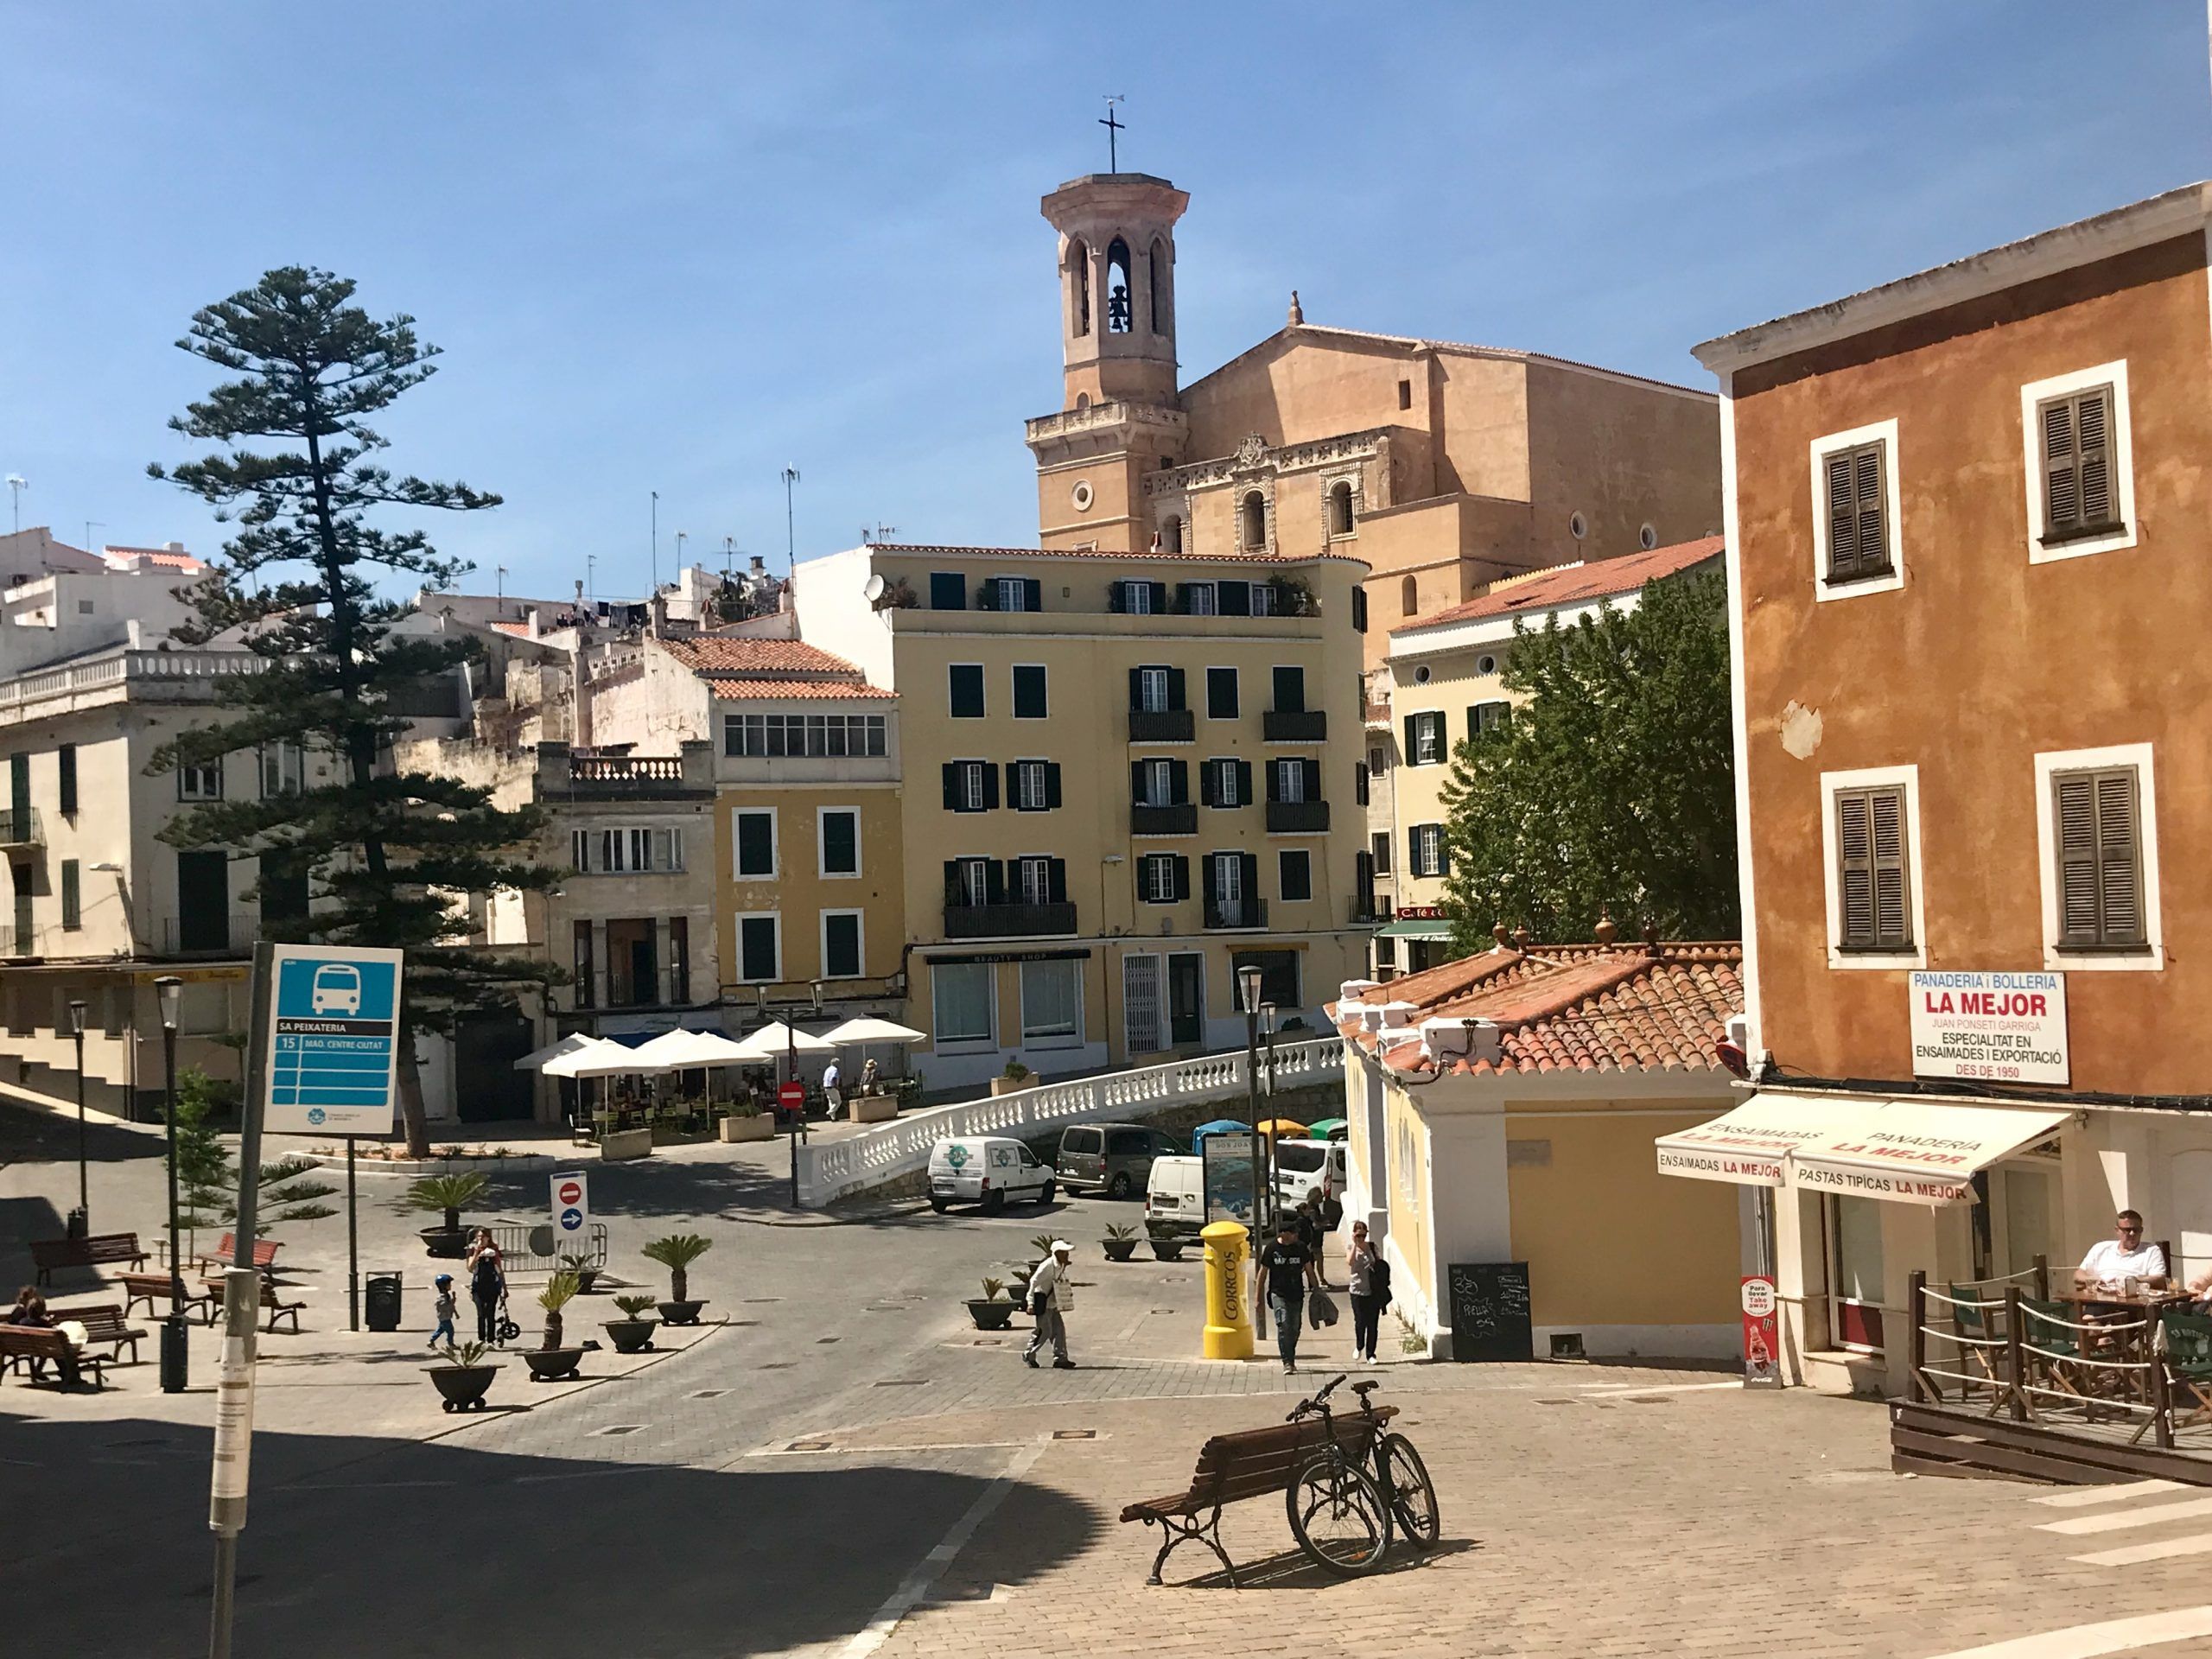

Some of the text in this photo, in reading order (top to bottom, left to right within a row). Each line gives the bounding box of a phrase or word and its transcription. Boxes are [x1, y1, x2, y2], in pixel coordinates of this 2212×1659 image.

[974, 954, 1011, 963] BEAUTY
[1914, 973, 1983, 988] PANADERIA
[1993, 975, 2057, 990] BOLLERIA
[1925, 992, 2047, 1017] LA MEJOR
[279, 1022, 346, 1033] SA PEIXATERIA
[1932, 1019, 2041, 1032] JUAN PONSETI GARRIGA
[282, 1038, 296, 1049] 15
[1942, 1033, 2031, 1048] ESPECIALITAT EN
[1916, 1045, 1984, 1060] ENSAIMADES
[1992, 1049, 2063, 1065] EXPORTACIÓ
[1955, 1064, 2019, 1078] DES DE 1950
[1707, 1123, 1982, 1151] ENSAIMADAS PANADERÍA
[1713, 1137, 1799, 1148] MEJOR
[1830, 1142, 1866, 1153] LA
[1868, 1147, 1967, 1164] MEJOR
[1660, 1154, 1781, 1178] ENSAIMADAS LA MEJOR
[1798, 1168, 1967, 1199] PASTAS TIPÍCAS LA MEJOR
